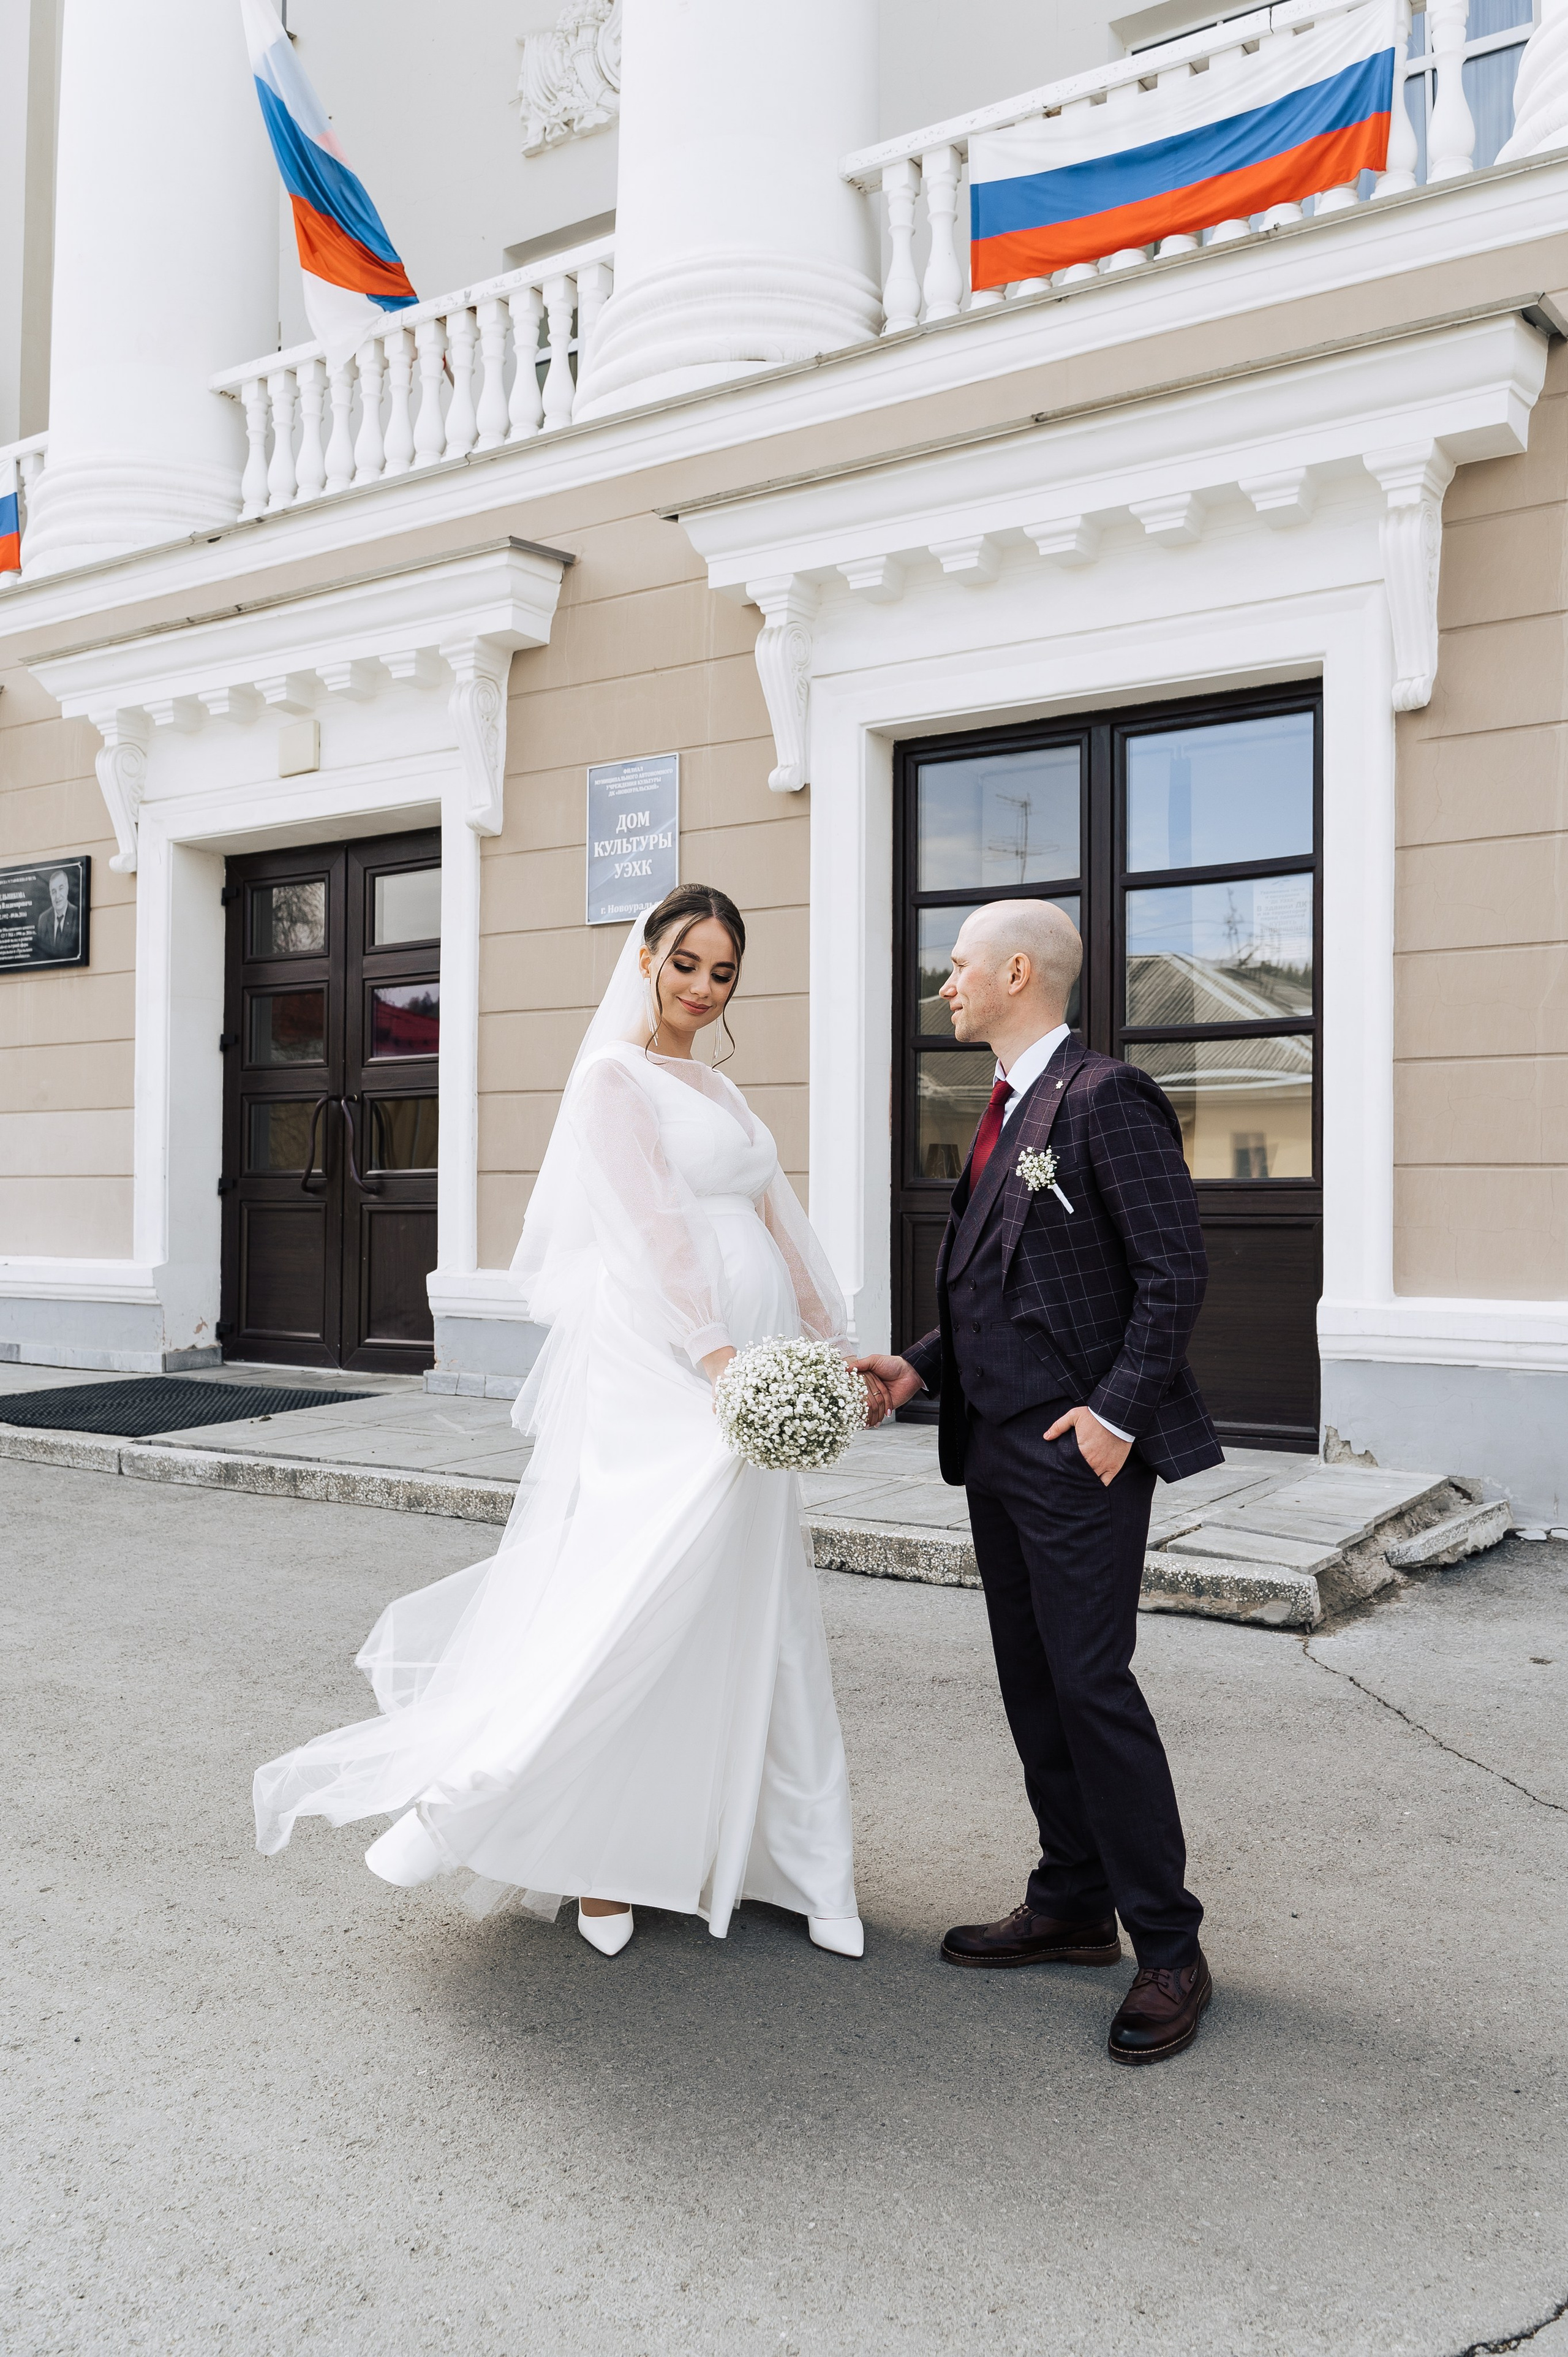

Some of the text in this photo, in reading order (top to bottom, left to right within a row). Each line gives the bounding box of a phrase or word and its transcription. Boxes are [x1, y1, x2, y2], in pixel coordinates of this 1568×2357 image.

[638, 777, 662, 785] КУЛЬТУРЫ
[616, 811, 650, 833] ДОМ
[594, 831, 673, 858] КУЛЬТУРЫ
[614, 859, 652, 879] УЭХК
[608, 901, 659, 914] Новоураль
